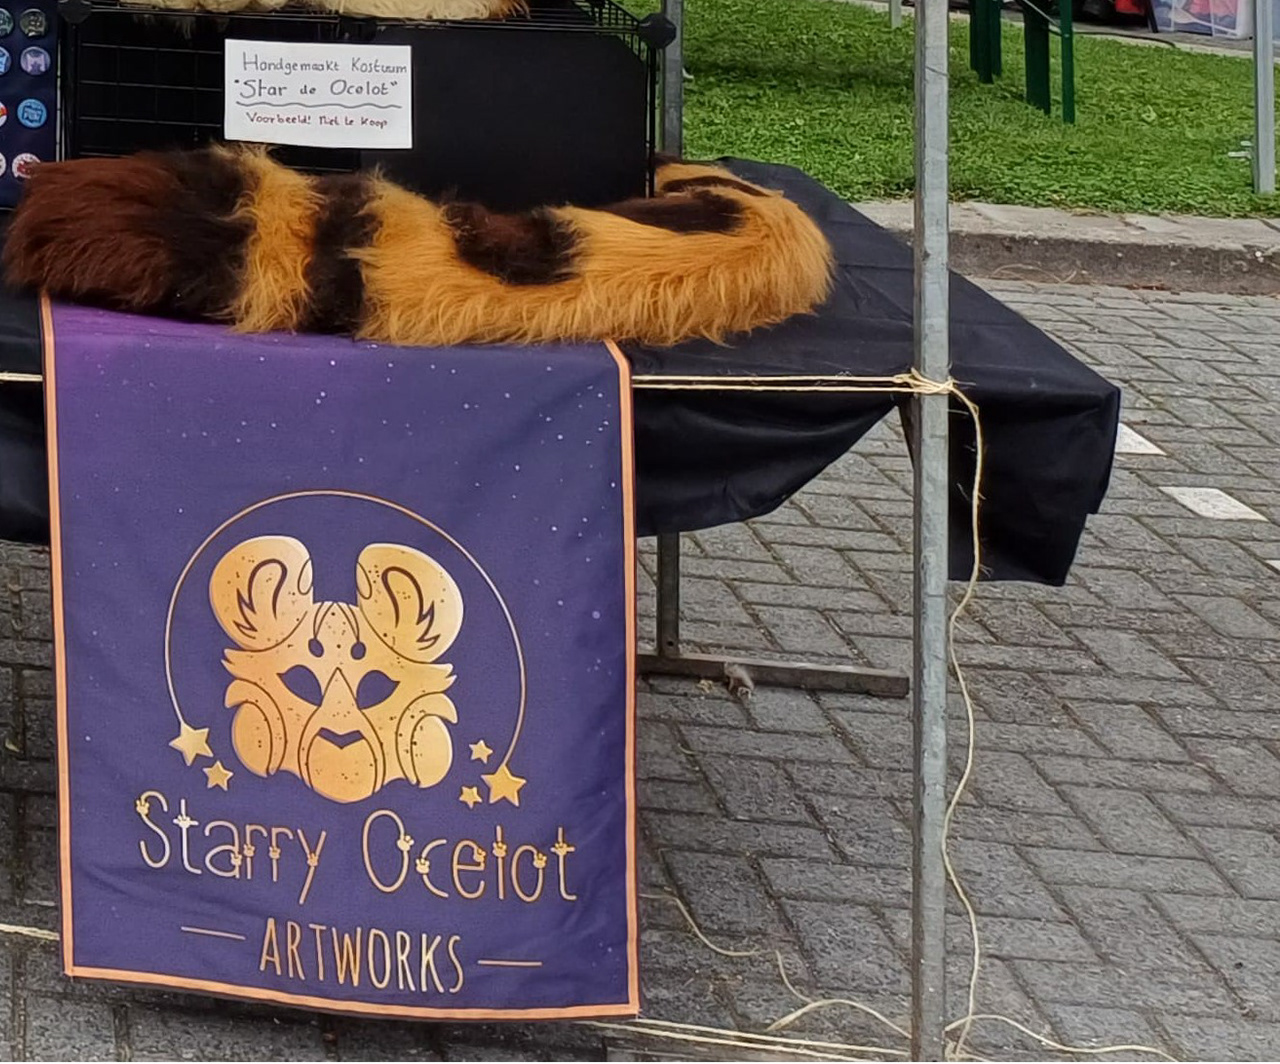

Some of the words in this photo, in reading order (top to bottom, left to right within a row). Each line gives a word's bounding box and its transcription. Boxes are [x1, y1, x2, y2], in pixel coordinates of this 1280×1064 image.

[242, 51, 340, 75] Handgemaakt
[299, 84, 316, 95] de
[246, 111, 312, 127] Voorbeeld!
[135, 790, 327, 905] Starry
[362, 809, 577, 903] Ocelot
[259, 917, 465, 994] ARTWORKS
